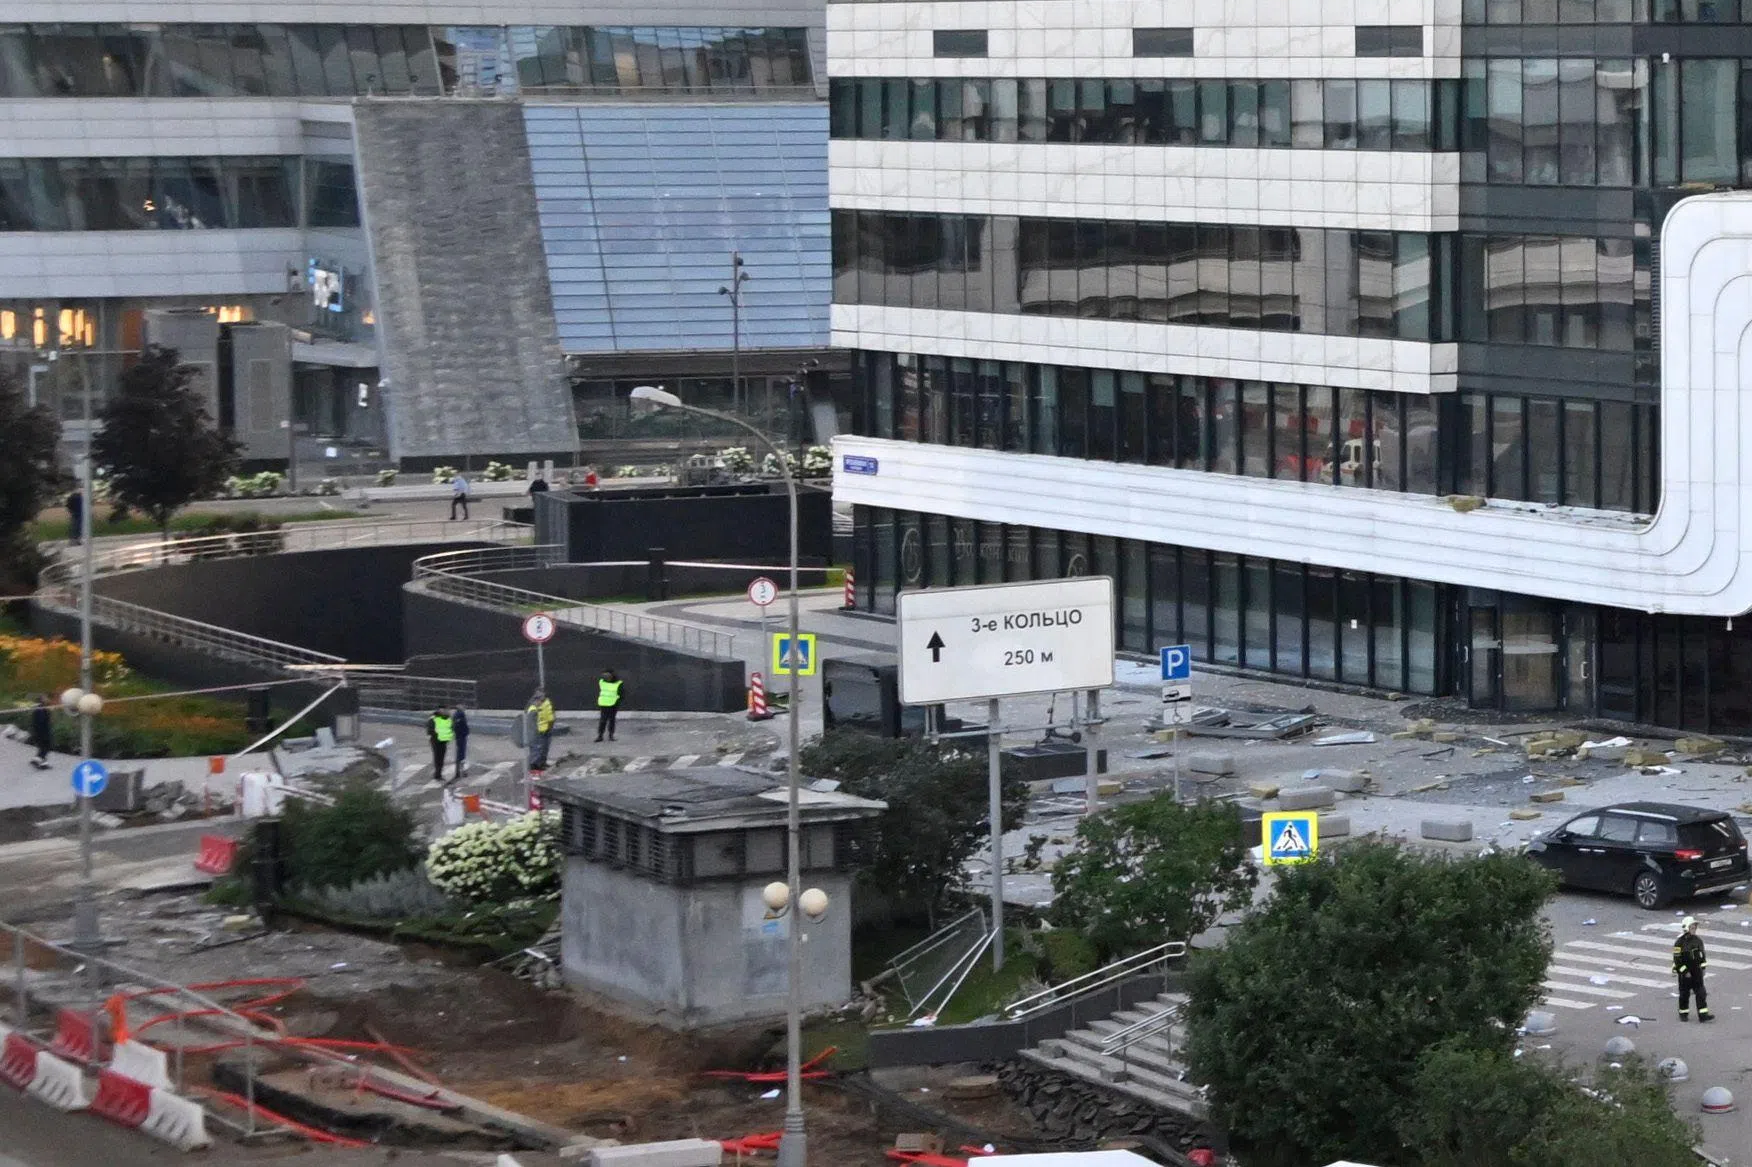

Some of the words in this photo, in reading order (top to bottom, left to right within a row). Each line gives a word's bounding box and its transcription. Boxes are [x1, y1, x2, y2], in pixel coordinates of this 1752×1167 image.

[971, 618, 998, 633] 3-е
[1004, 609, 1082, 631] КОЛЬЦО
[1004, 649, 1034, 666] 250
[1041, 651, 1053, 663] м
[1167, 649, 1184, 677] P
